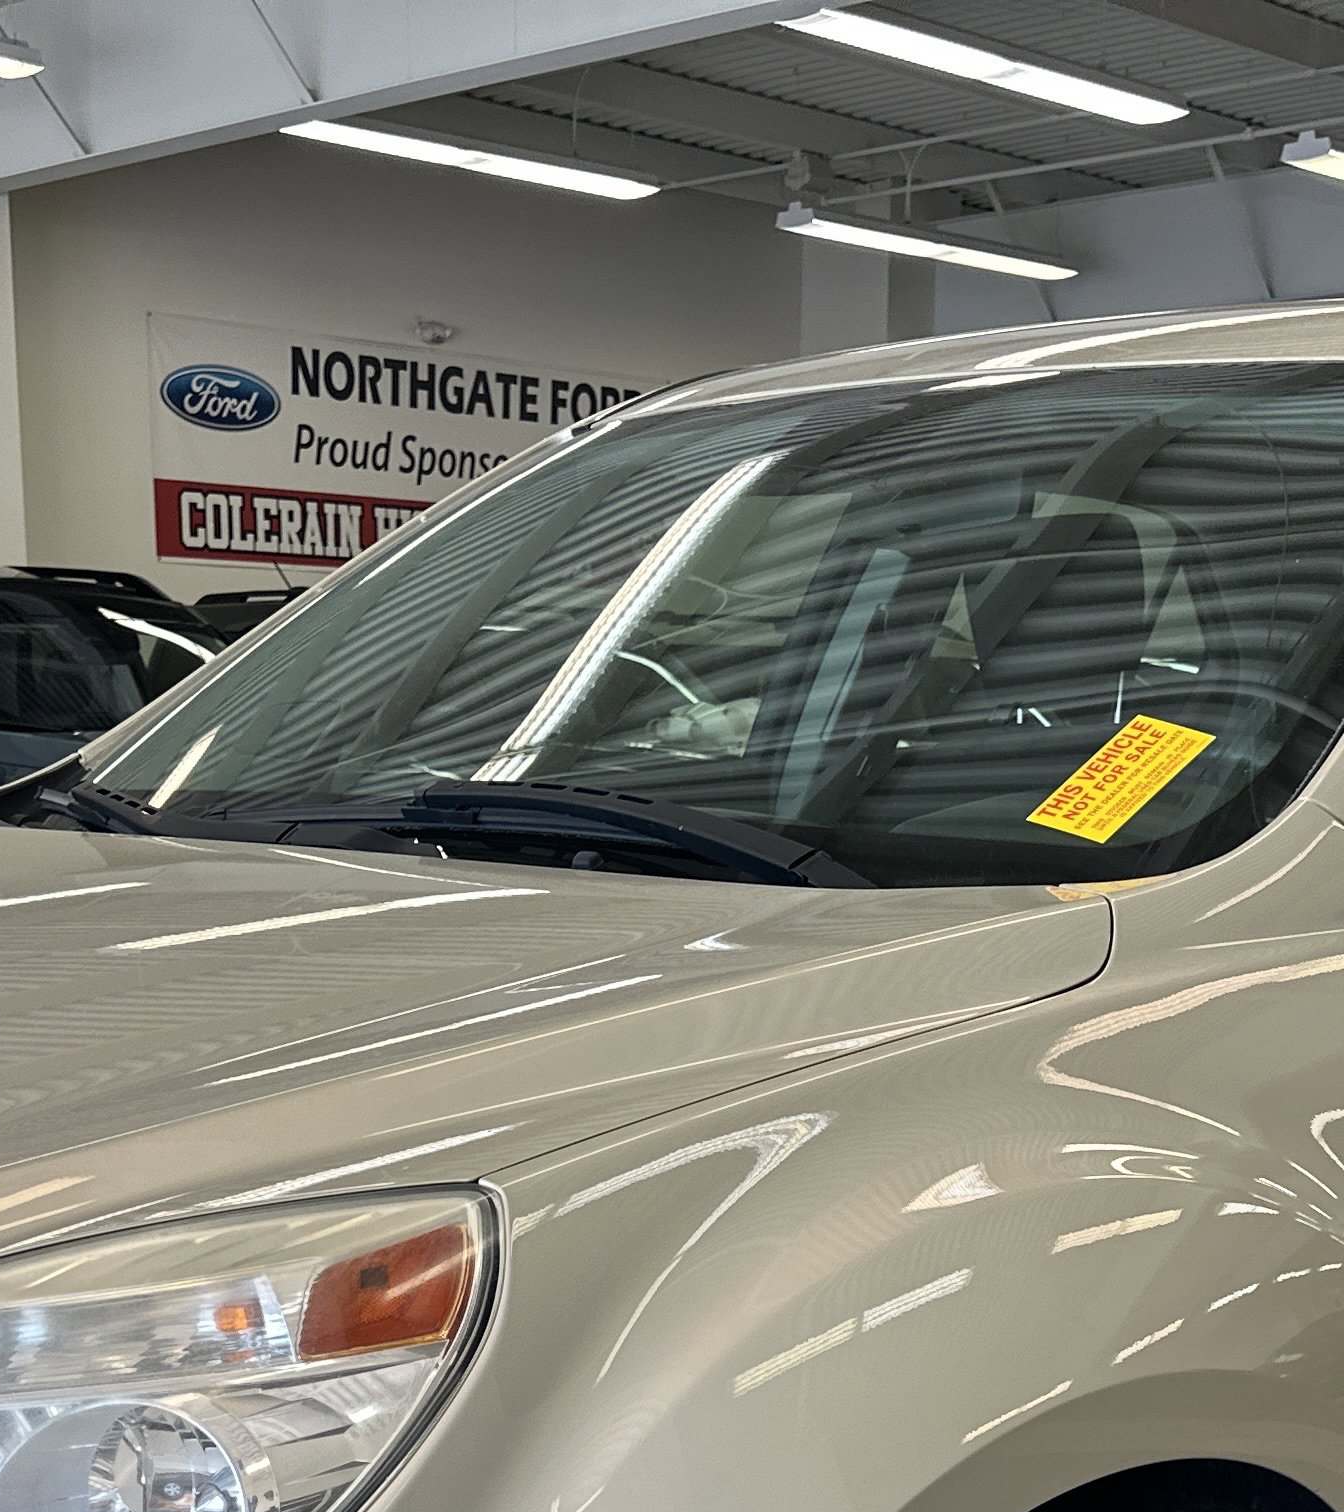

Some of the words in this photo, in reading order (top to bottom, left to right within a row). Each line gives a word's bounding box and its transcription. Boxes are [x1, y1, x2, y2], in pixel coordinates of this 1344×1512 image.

[183, 373, 259, 423] Ford
[291, 346, 540, 423] NORTHGATE
[551, 379, 642, 425] FO
[294, 423, 392, 473] Proud
[179, 488, 365, 558] COLERAIN
[1035, 782, 1086, 820] THIS
[1074, 719, 1154, 783] VEHICLE
[1060, 792, 1099, 821] NOT
[1091, 763, 1130, 792] FOR
[1122, 727, 1168, 763] SALE
[1099, 779, 1130, 805] DEALER
